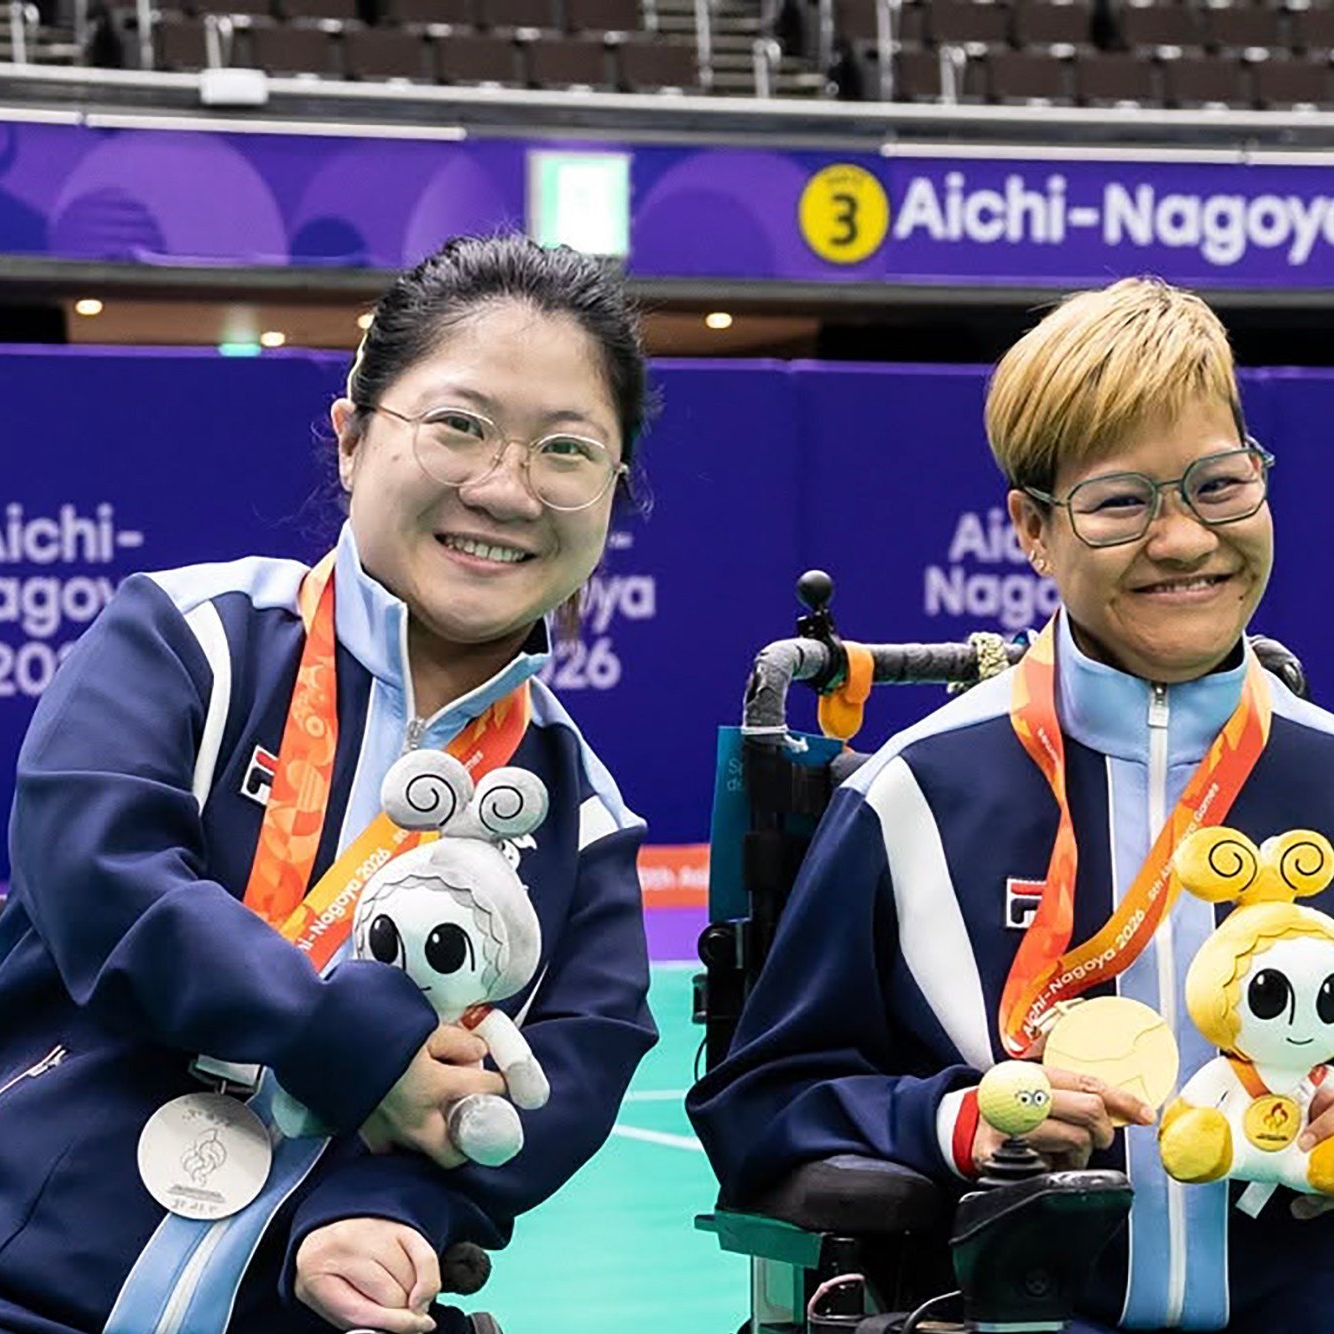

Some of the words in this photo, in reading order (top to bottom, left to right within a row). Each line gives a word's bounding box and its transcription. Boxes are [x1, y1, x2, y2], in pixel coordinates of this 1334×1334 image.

[829, 192, 858, 246] 3
[355, 847, 393, 882] 2026
[1115, 908, 1146, 950] 2026
